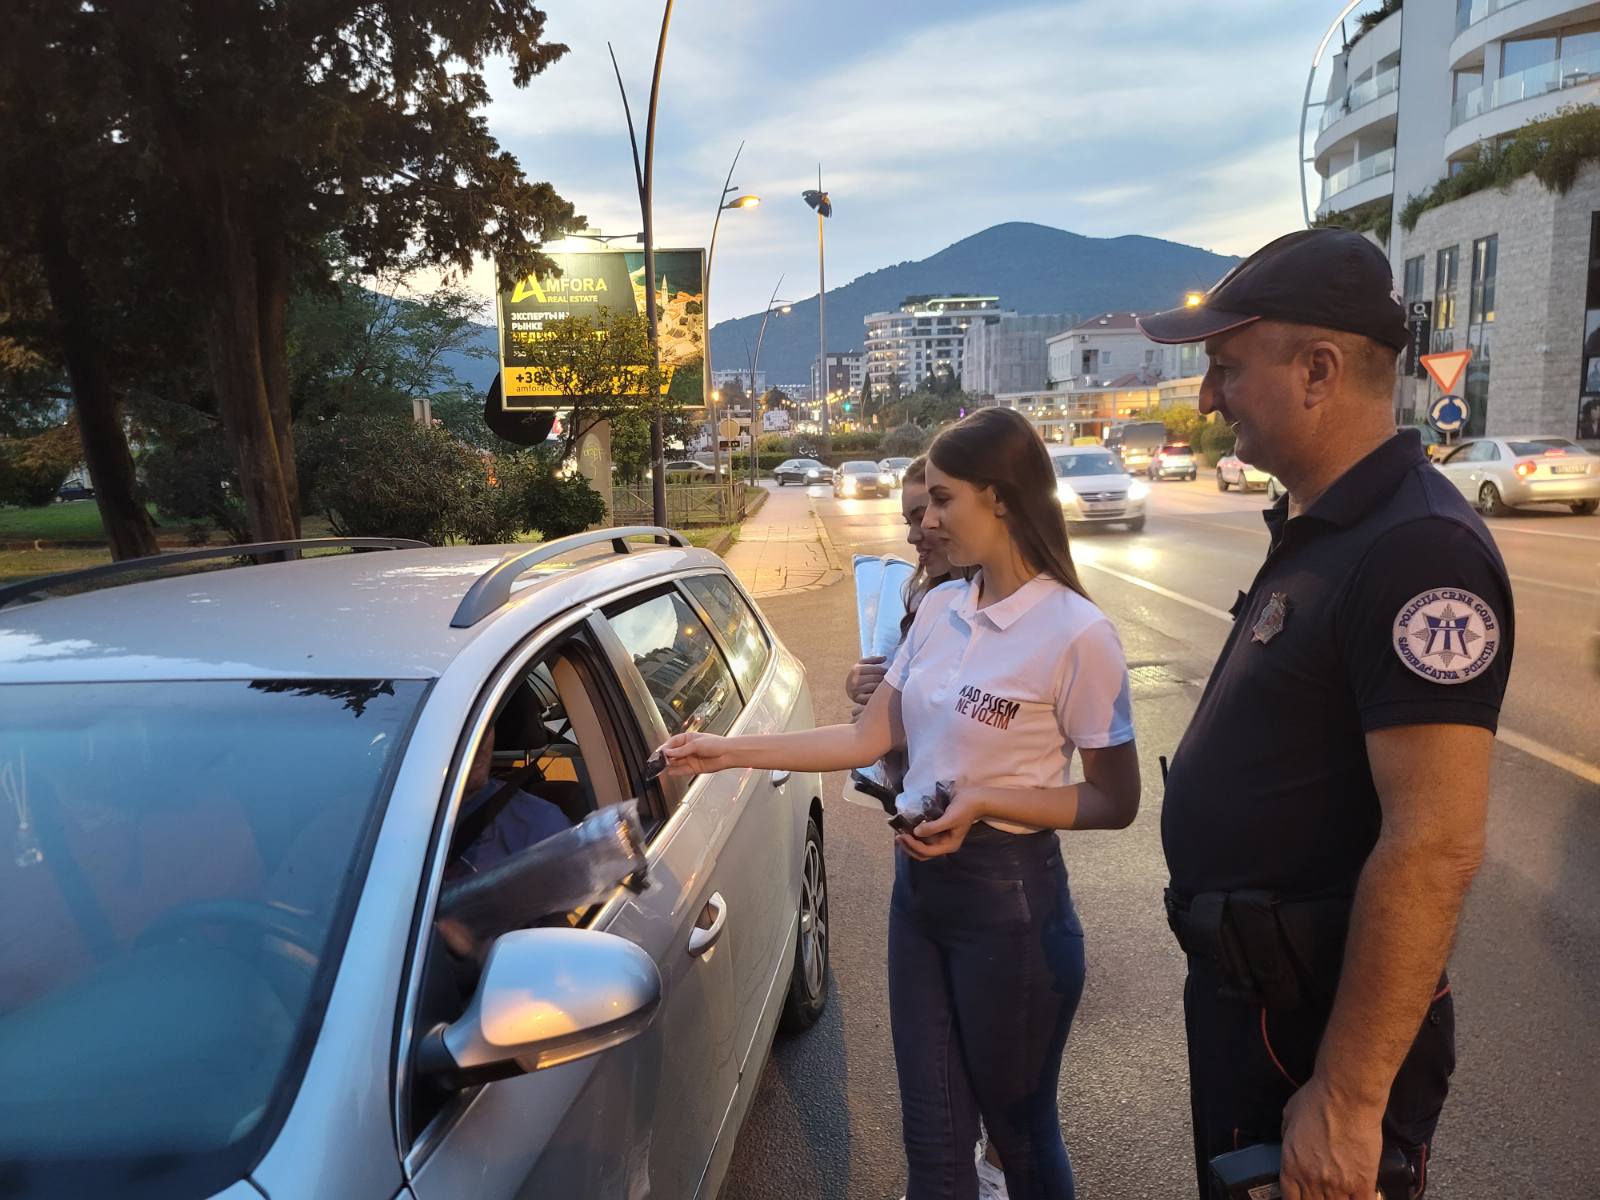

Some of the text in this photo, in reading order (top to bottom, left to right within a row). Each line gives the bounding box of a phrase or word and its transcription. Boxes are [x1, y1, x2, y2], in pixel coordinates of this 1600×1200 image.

[511, 271, 607, 302] AMFORA
[547, 295, 599, 303] REAL ESTATE
[511, 312, 558, 321] ЭКСПЕРТЫ
[511, 322, 544, 331] РЫНКЕ
[1399, 593, 1440, 628] POLICIJA
[1463, 641, 1495, 676] POLICIJA
[959, 685, 981, 702] KAD
[955, 698, 1010, 729] NE VOZIM
